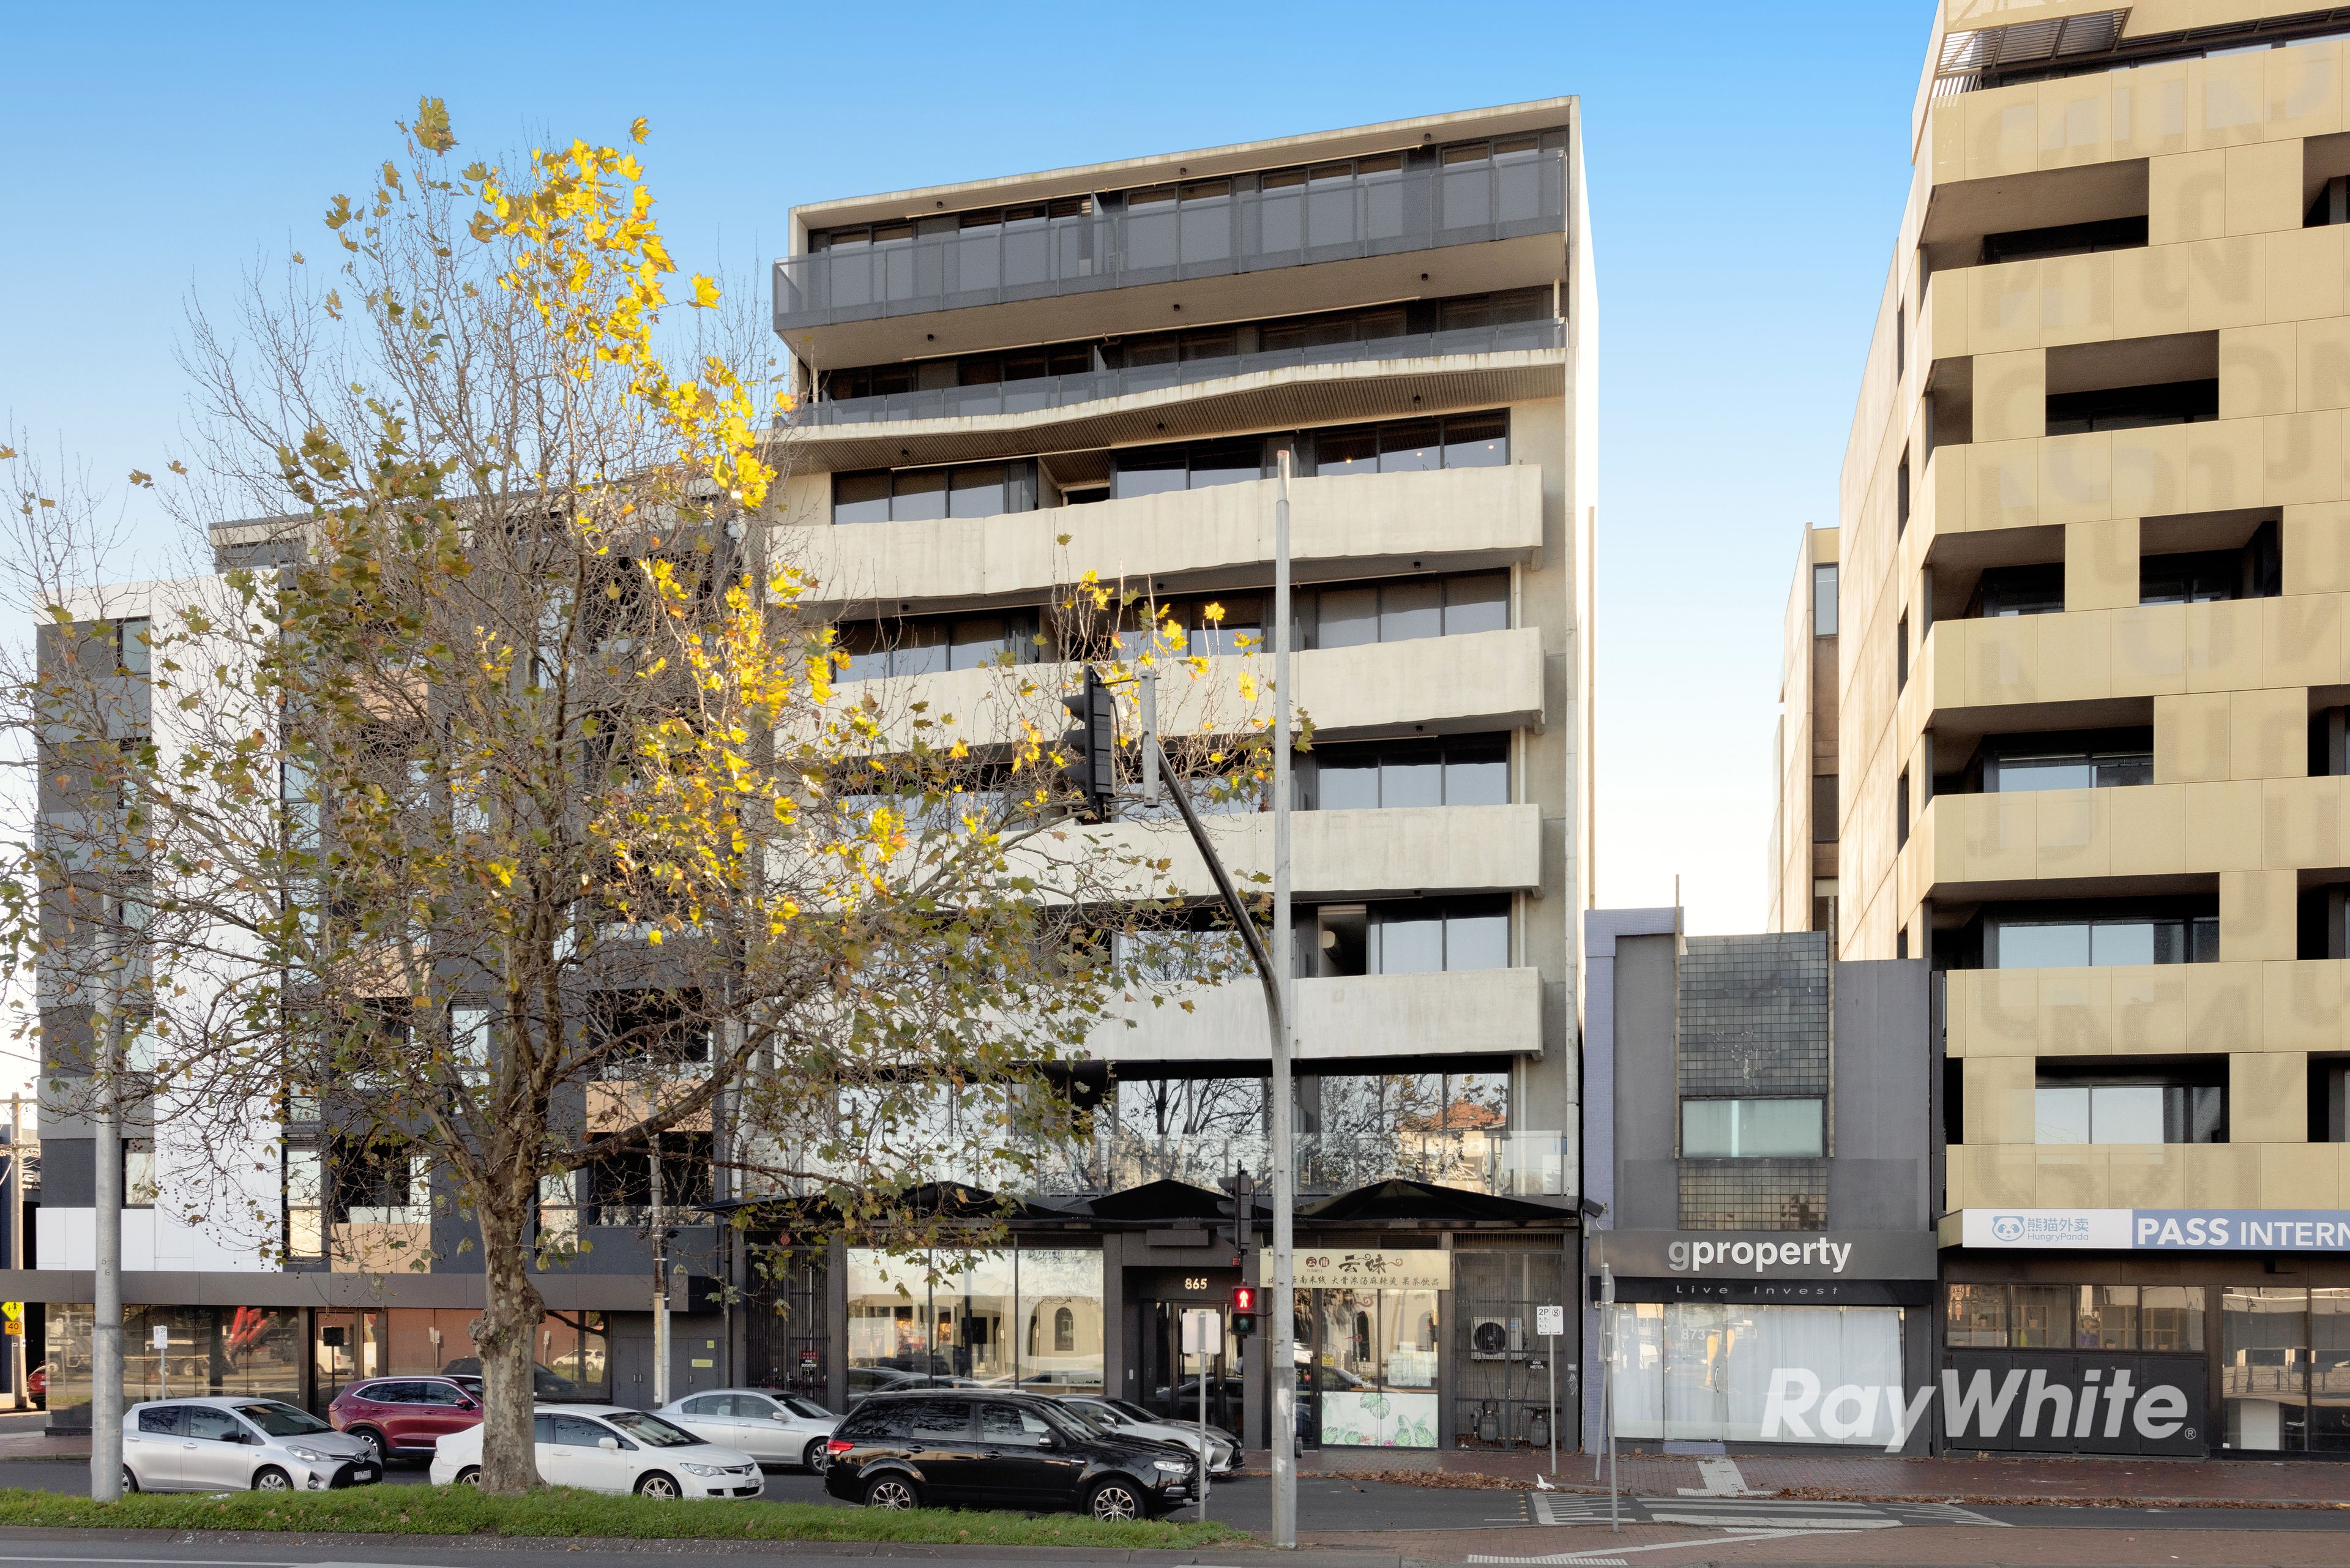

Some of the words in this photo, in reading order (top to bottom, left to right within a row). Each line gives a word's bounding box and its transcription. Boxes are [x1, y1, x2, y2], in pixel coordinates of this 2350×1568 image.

[2027, 1217, 2089, 1232] 熊猫外卖
[2027, 1233, 2089, 1242] HungryPanda
[2138, 1218, 2229, 1246] PASS
[1668, 1237, 1852, 1274] gproperty
[1306, 1256, 1330, 1267] 云南
[1338, 1253, 1391, 1274] 云味
[1185, 1278, 1207, 1290] 865
[1402, 1277, 1439, 1286] 果茶饮品
[1676, 1285, 1728, 1294] Live
[1754, 1286, 1838, 1295] Invest
[1682, 1329, 1706, 1340] 873
